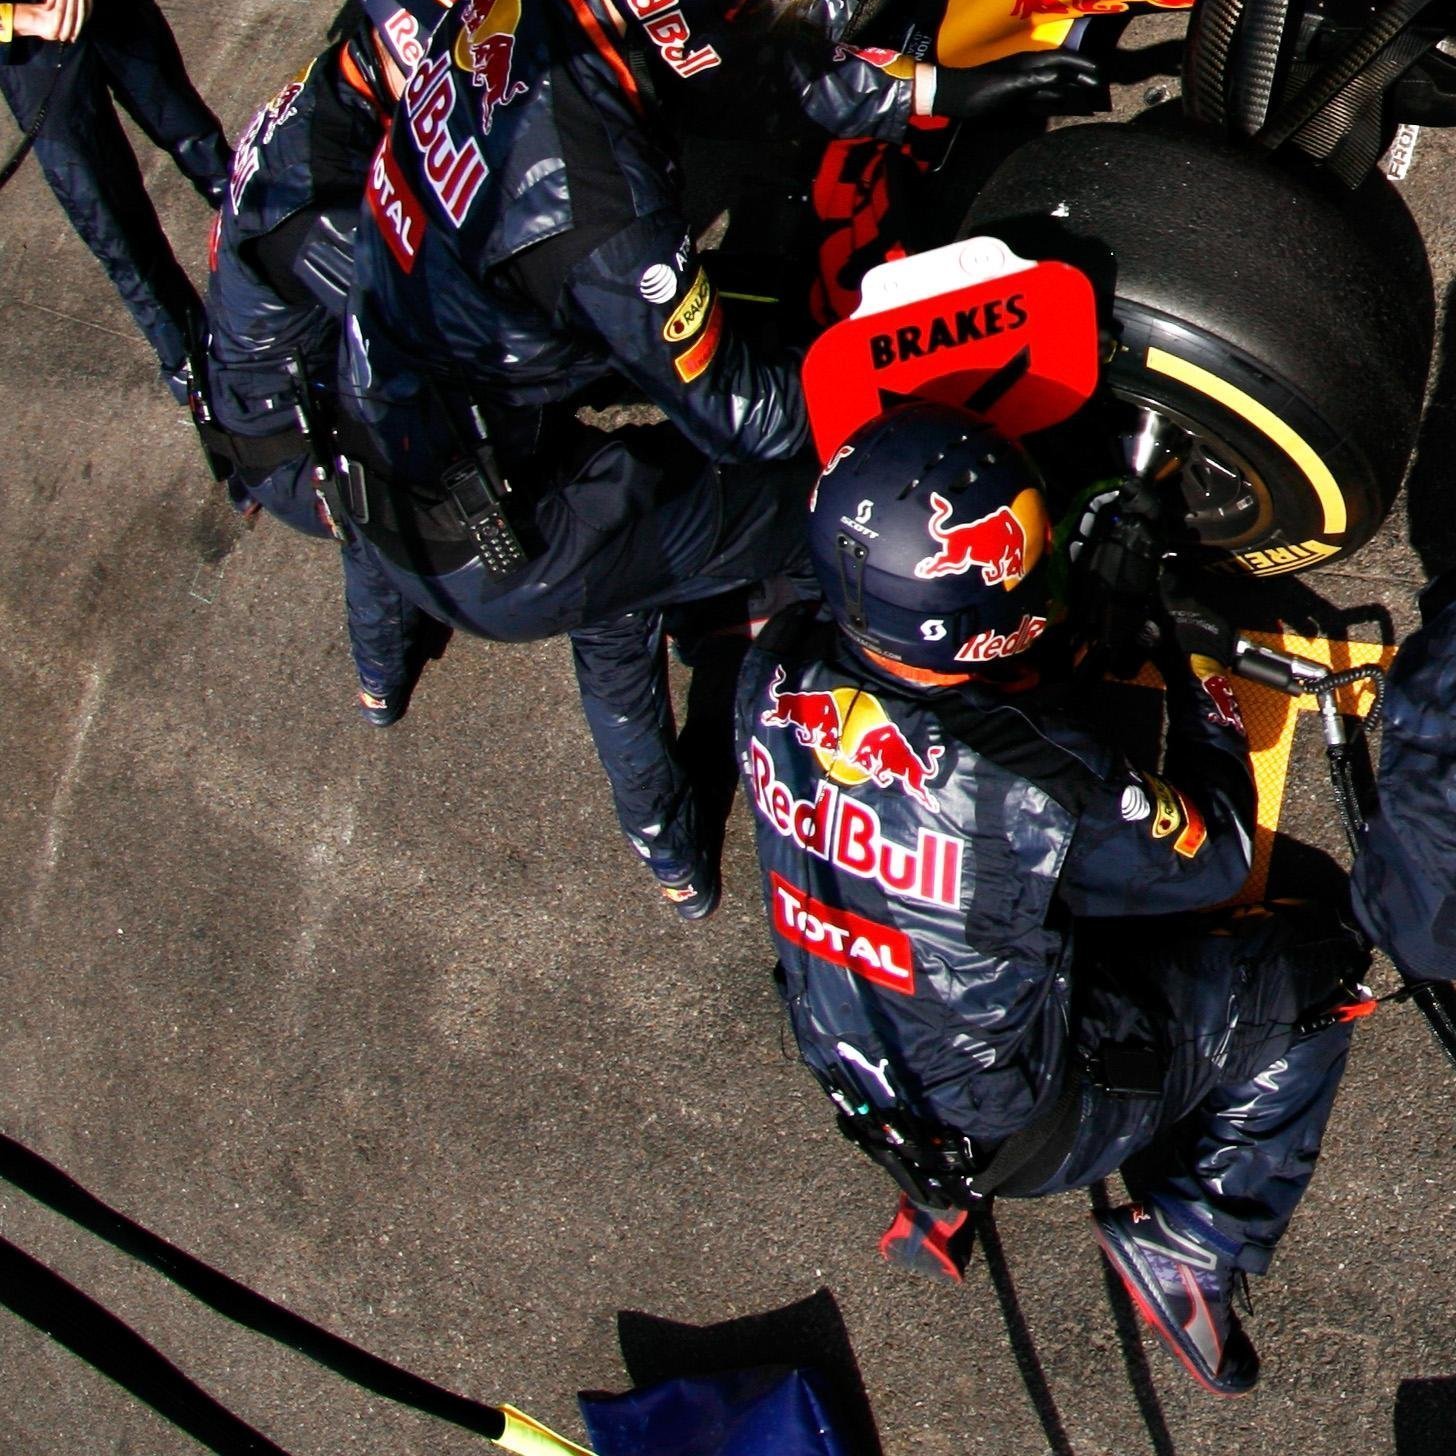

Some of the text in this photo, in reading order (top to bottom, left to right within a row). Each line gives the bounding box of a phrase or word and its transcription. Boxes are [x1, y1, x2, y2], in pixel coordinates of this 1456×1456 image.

[870, 293, 1029, 371] BRAKES
[839, 515, 880, 539] SCOTT
[776, 885, 909, 978] TOTAL
